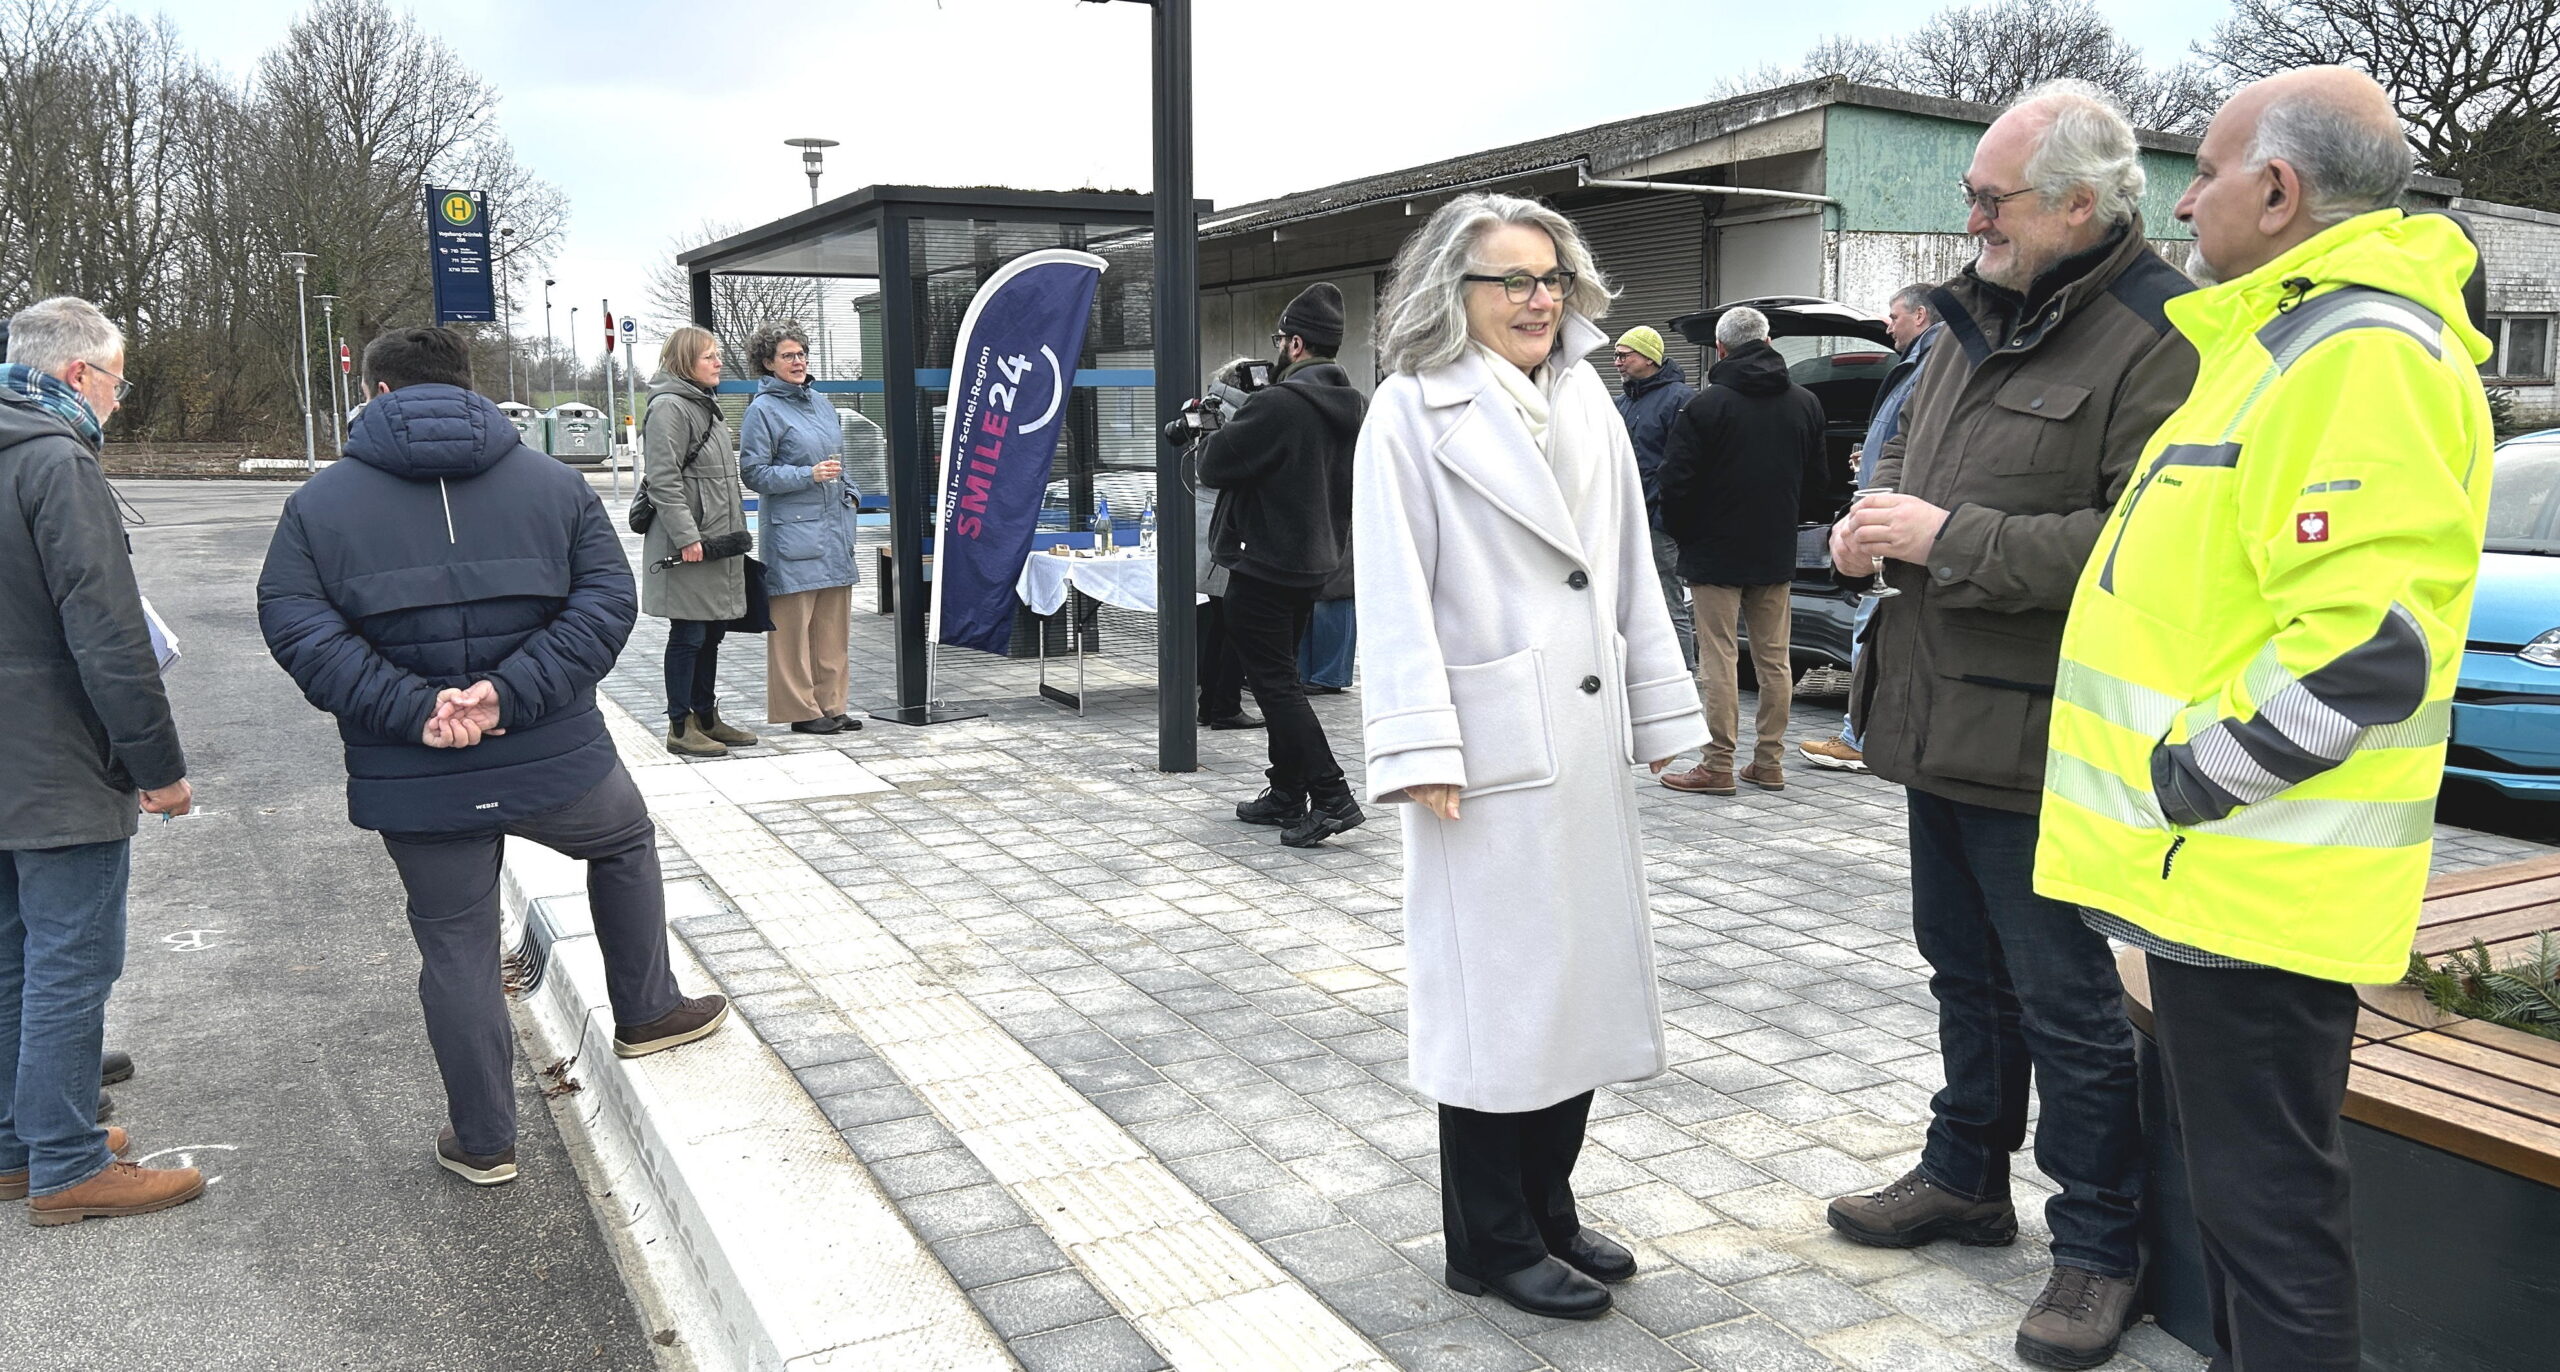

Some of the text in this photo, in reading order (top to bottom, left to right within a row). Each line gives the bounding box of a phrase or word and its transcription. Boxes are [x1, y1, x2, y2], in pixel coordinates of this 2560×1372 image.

[452, 200, 466, 218] H
[959, 345, 991, 444] Schlei-Region
[956, 445, 966, 471] der
[957, 354, 1033, 539] SMILE24
[945, 490, 958, 531] obil
